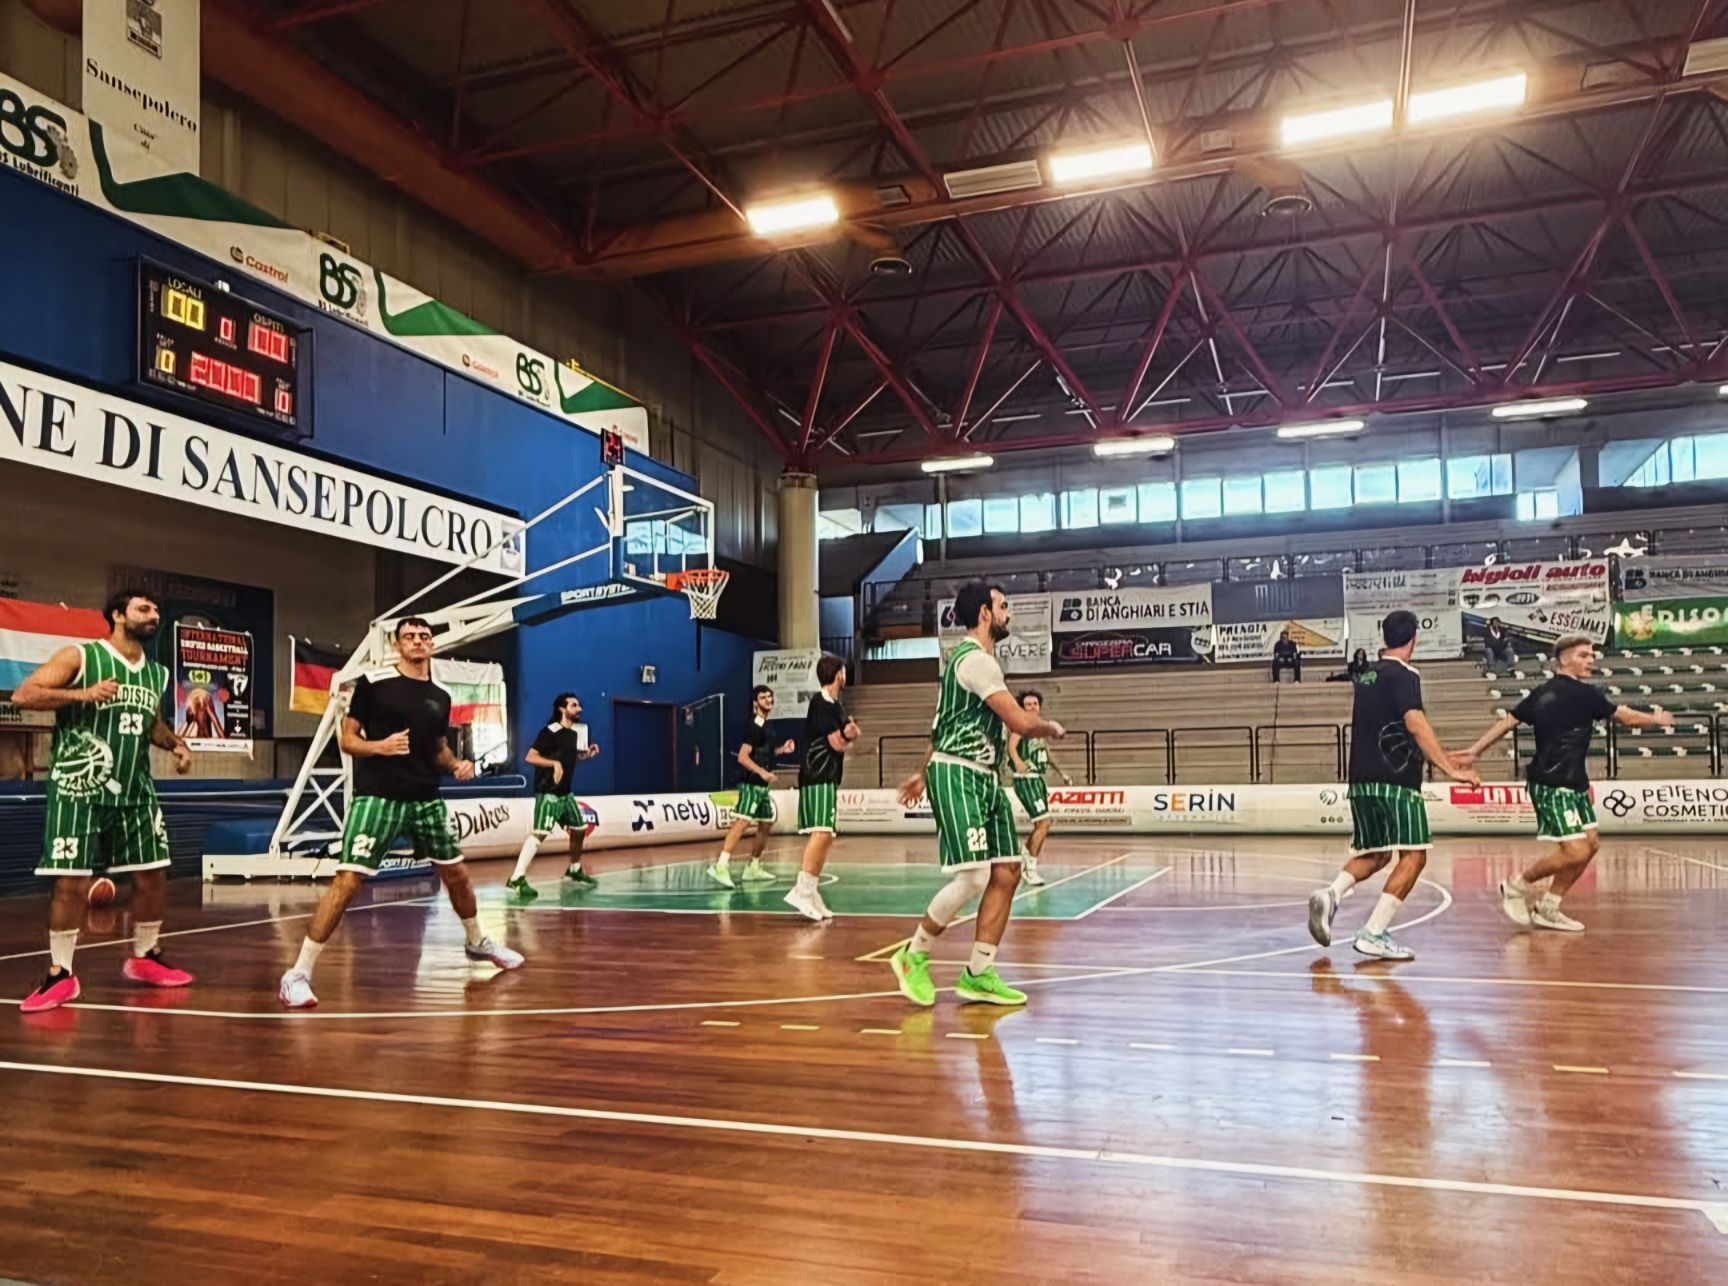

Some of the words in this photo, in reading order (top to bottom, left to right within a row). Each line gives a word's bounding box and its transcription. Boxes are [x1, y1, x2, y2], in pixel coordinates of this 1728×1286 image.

[246, 255, 289, 283] Castrol
[96, 408, 167, 481] DI
[181, 435, 493, 559] SANSEPOLCRO
[1546, 563, 1606, 579] auto
[1086, 595, 1121, 608] BANCA
[1086, 608, 1099, 621] DI
[1101, 604, 1165, 621] ANGHIARI
[1168, 603, 1176, 617] E
[1179, 601, 1209, 617] STIA
[994, 642, 1048, 658] EVERE
[118, 712, 144, 735] 23
[455, 804, 510, 840] Dukes
[662, 799, 710, 826] nety
[1643, 805, 1728, 817] COSMETI
[52, 837, 79, 859] 23
[351, 834, 376, 858] 21
[966, 827, 988, 852] 22
